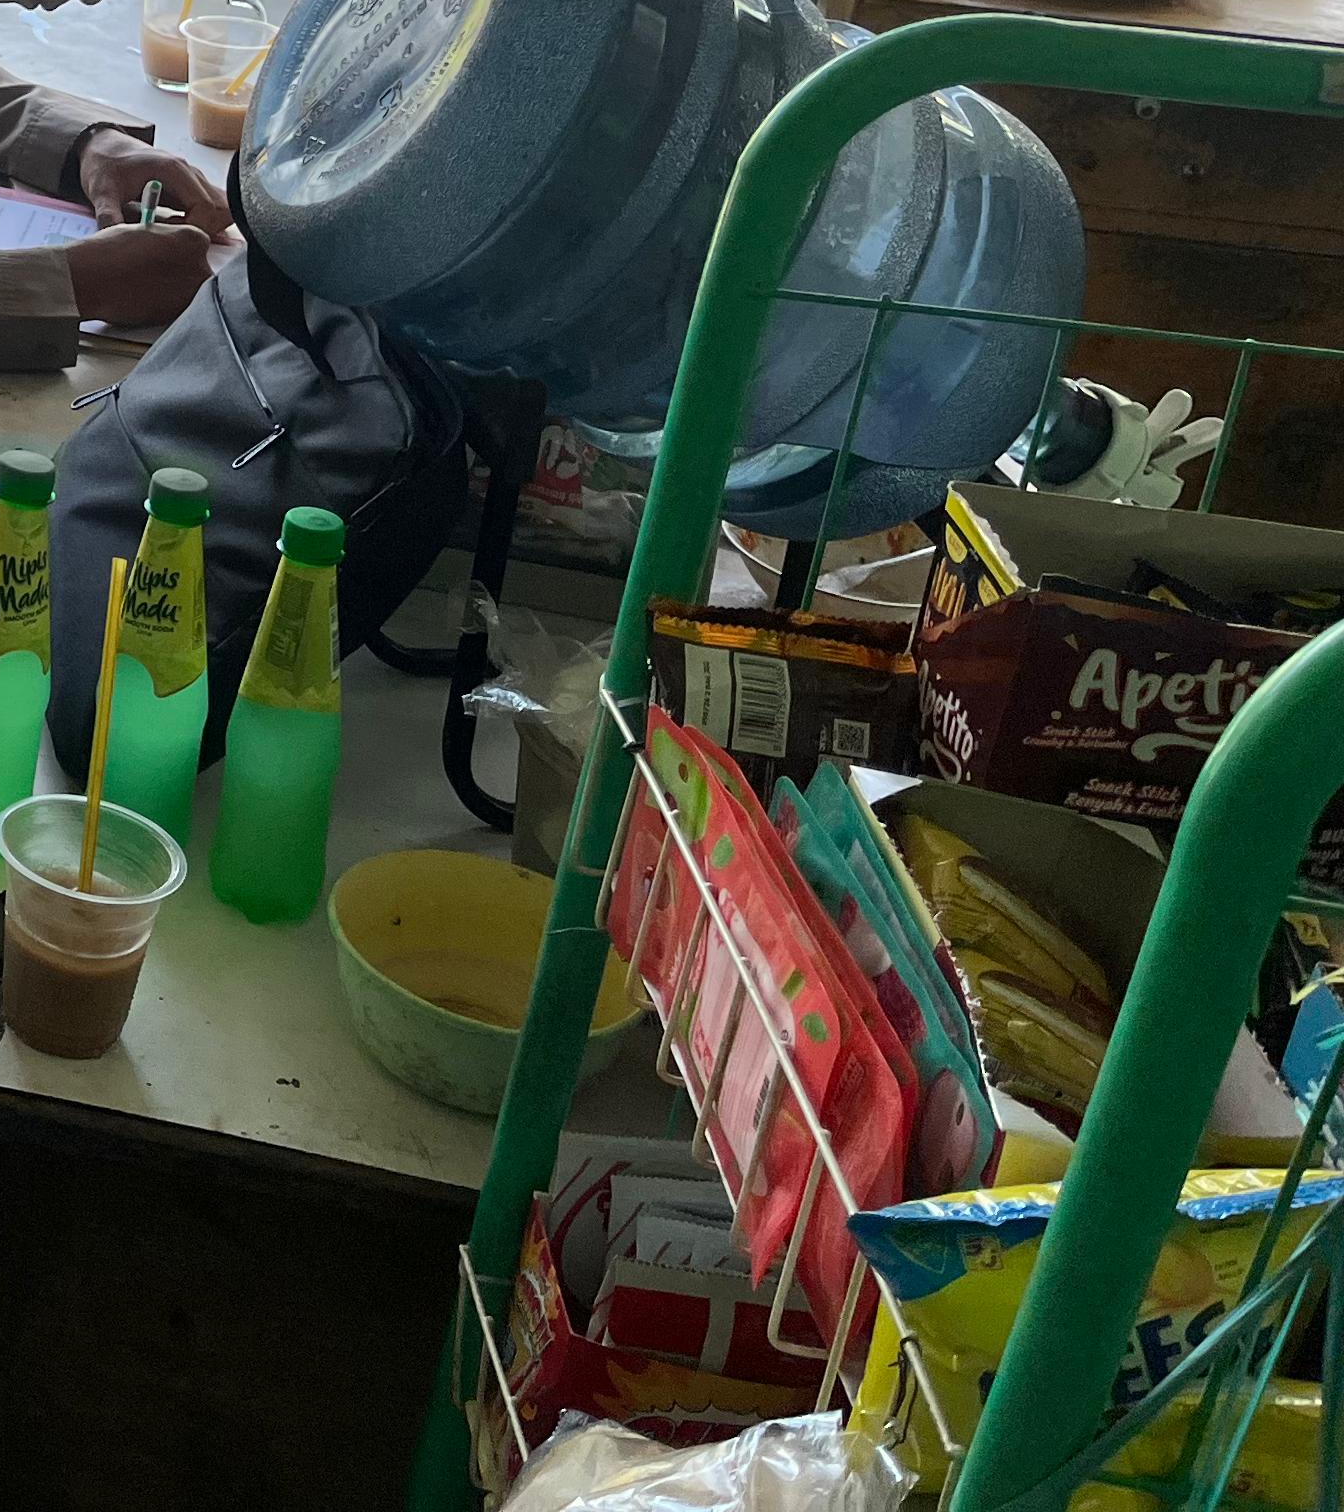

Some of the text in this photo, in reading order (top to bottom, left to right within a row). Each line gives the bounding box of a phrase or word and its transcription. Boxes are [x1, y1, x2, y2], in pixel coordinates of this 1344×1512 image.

[121, 589, 180, 623] Madu
[125, 618, 151, 631] MOOTH
[1068, 647, 1278, 731] Apeti
[1083, 777, 1181, 803] Snack Stick
